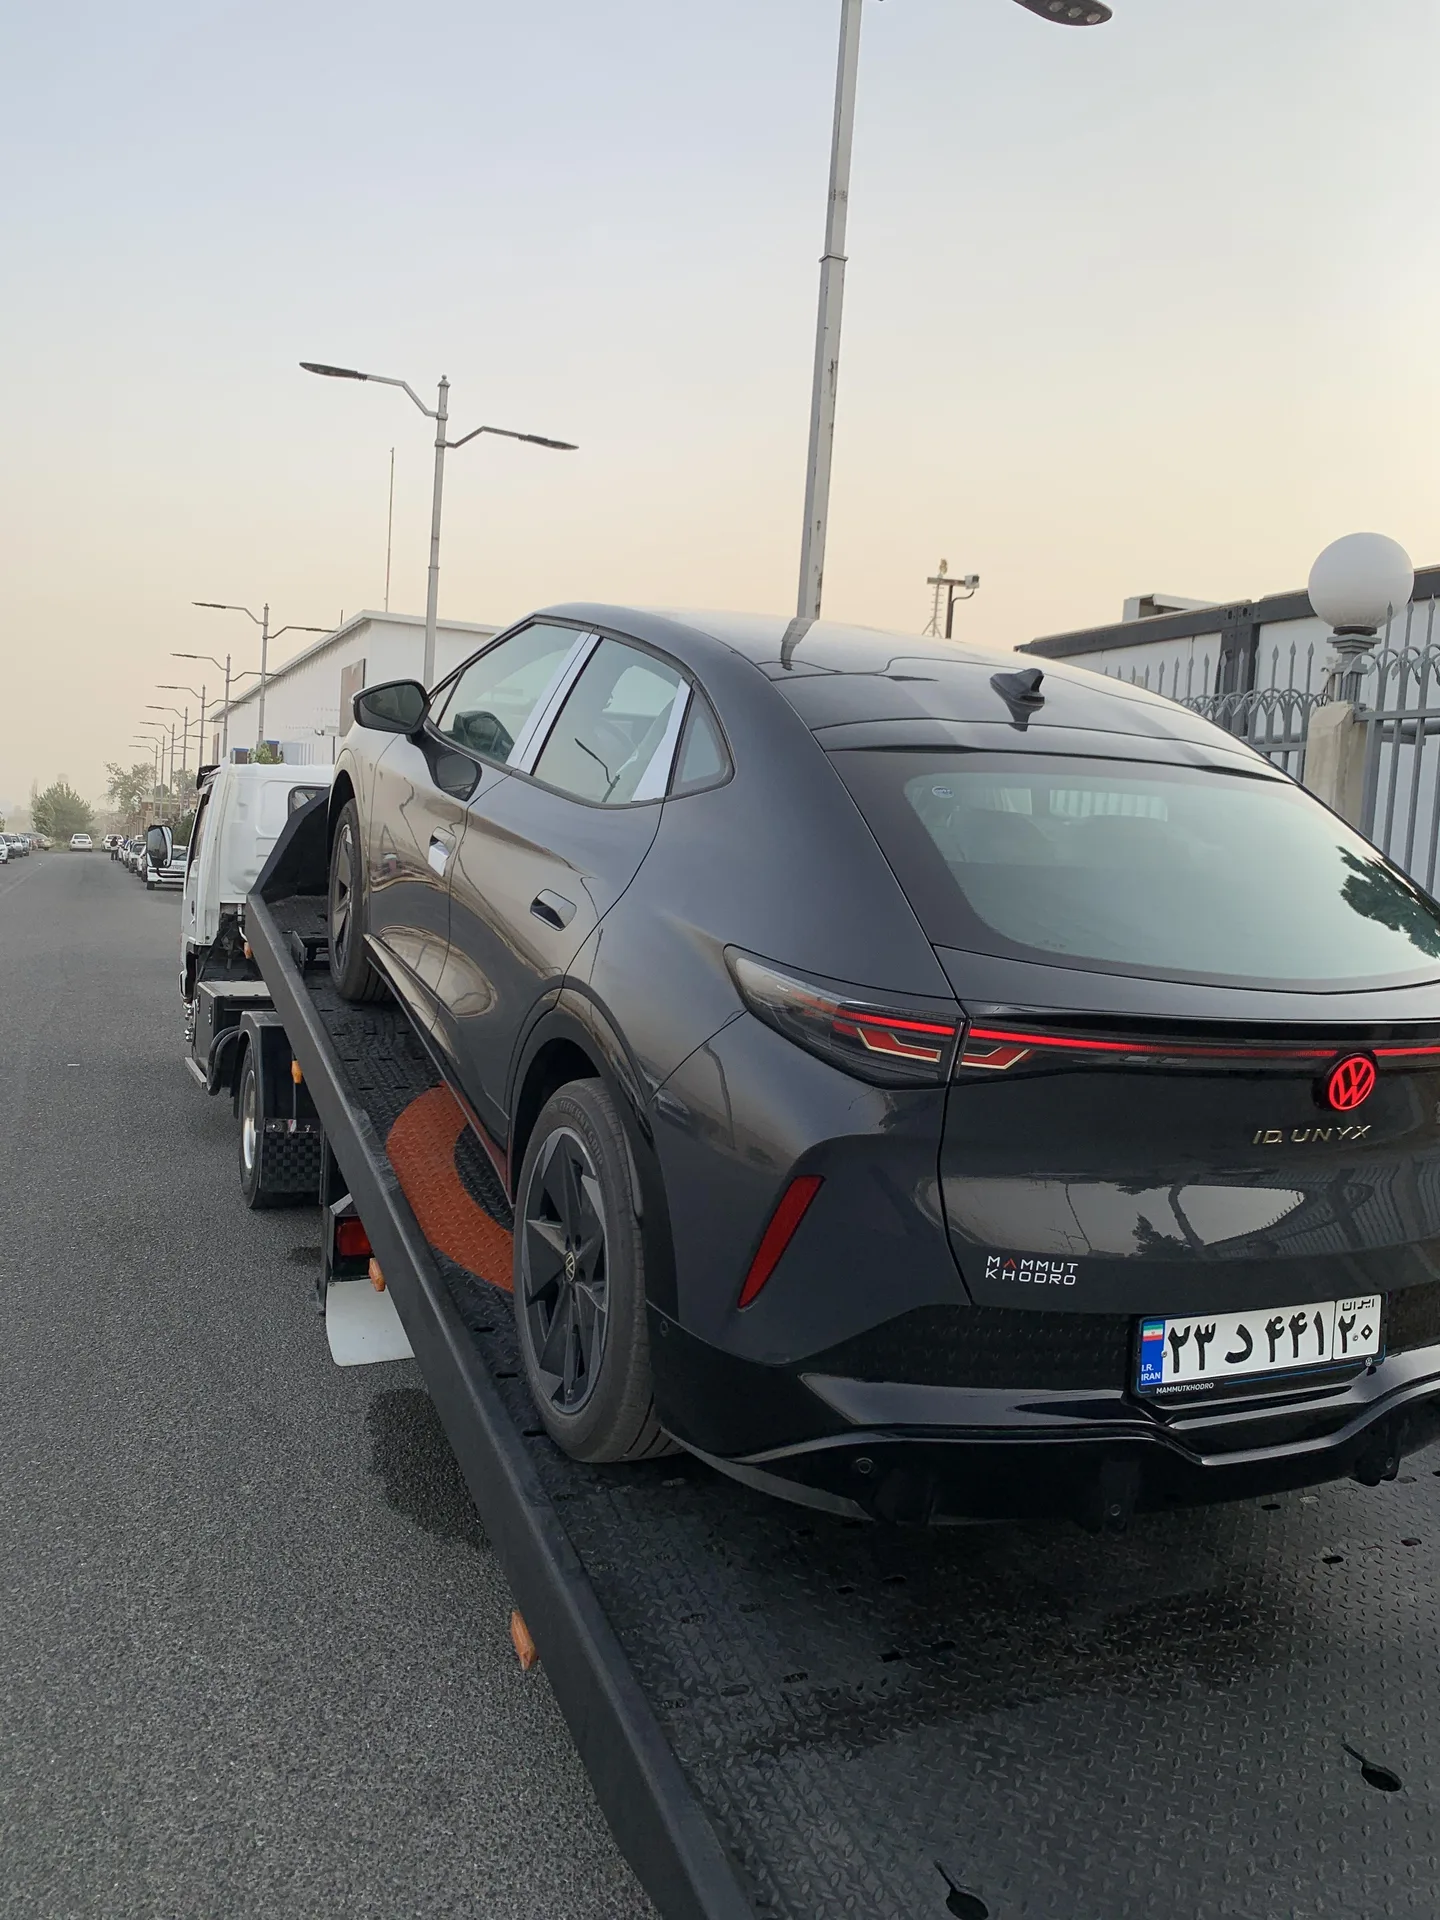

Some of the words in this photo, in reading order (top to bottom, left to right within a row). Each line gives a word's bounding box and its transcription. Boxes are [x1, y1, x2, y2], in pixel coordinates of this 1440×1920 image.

[1291, 1125, 1372, 1142] UNYX
[986, 1254, 1080, 1274] MAMMUT
[984, 1268, 1077, 1287] KHODRO
[1342, 1298, 1375, 1310] ایران
[1141, 1363, 1154, 1372] I.R.
[1141, 1371, 1161, 1380] IRAN
[1156, 1383, 1214, 1394] MAMMUTKHODRO
